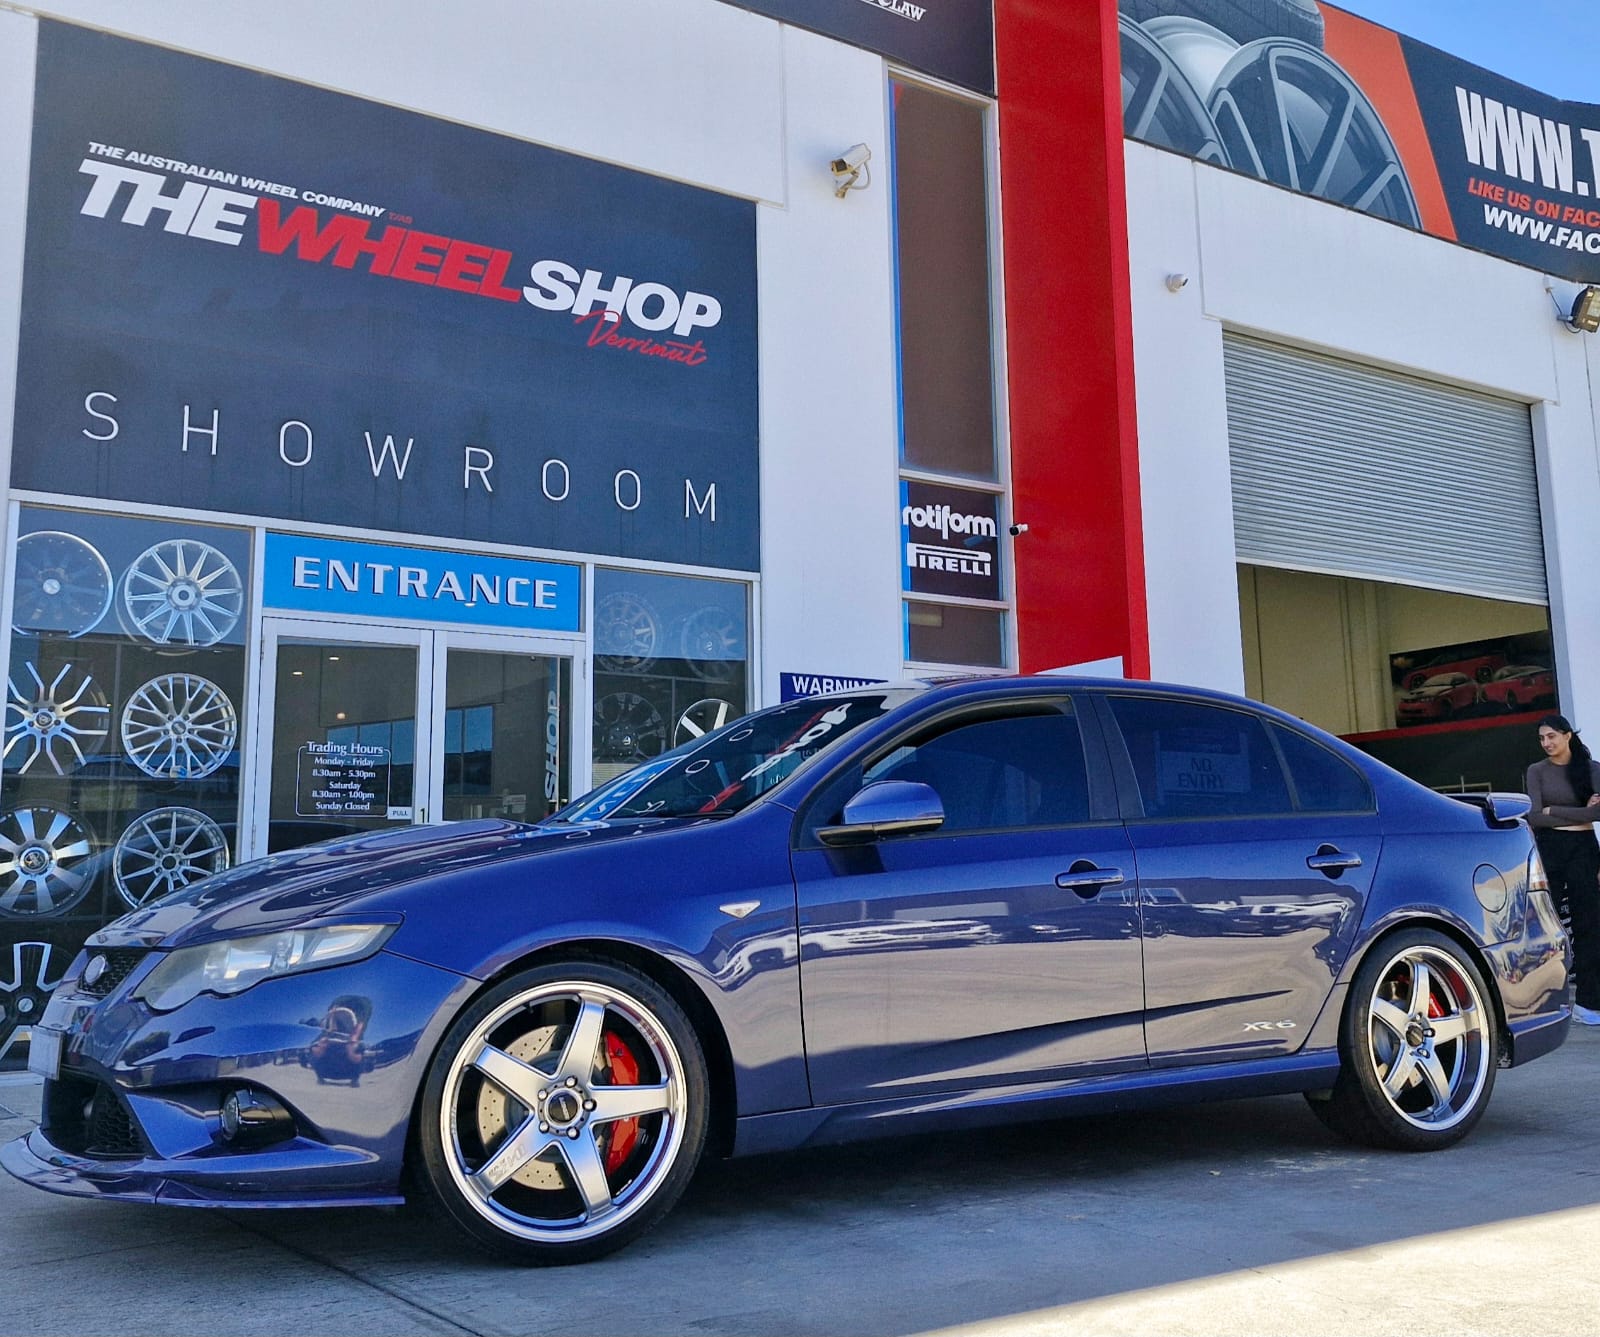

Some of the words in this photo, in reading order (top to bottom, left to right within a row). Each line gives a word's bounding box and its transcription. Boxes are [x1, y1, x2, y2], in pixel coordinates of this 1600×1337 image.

[873, 0, 926, 21] CLAW
[88, 141, 125, 160] THE
[125, 151, 238, 185] AUSTRALIAN
[241, 176, 298, 199] WHEEL
[302, 190, 387, 218] COMPANY
[1468, 177, 1505, 203] LIKE
[1507, 190, 1531, 211] US
[1534, 199, 1560, 219] ON
[1562, 206, 1600, 228] FAC
[1484, 203, 1600, 254] WWW.FAC
[82, 391, 717, 522] SHOWROOM
[902, 504, 997, 540] rotiform
[907, 542, 991, 576] PIRELLI
[292, 556, 559, 609] ENTRANCE
[306, 741, 347, 755] Trading
[351, 743, 384, 754] Hours
[314, 757, 345, 767] Monday
[352, 758, 375, 768] Friday
[1191, 757, 1212, 772] NO
[312, 768, 341, 777] 8.30am
[348, 769, 376, 779] 5.30pm
[1178, 772, 1224, 789] ENTRY
[312, 790, 340, 798] 8.30am
[329, 781, 361, 791] Saturday
[315, 801, 342, 811] Sunday
[345, 802, 370, 811] Closed
[1242, 1020, 1296, 1032] XR6
